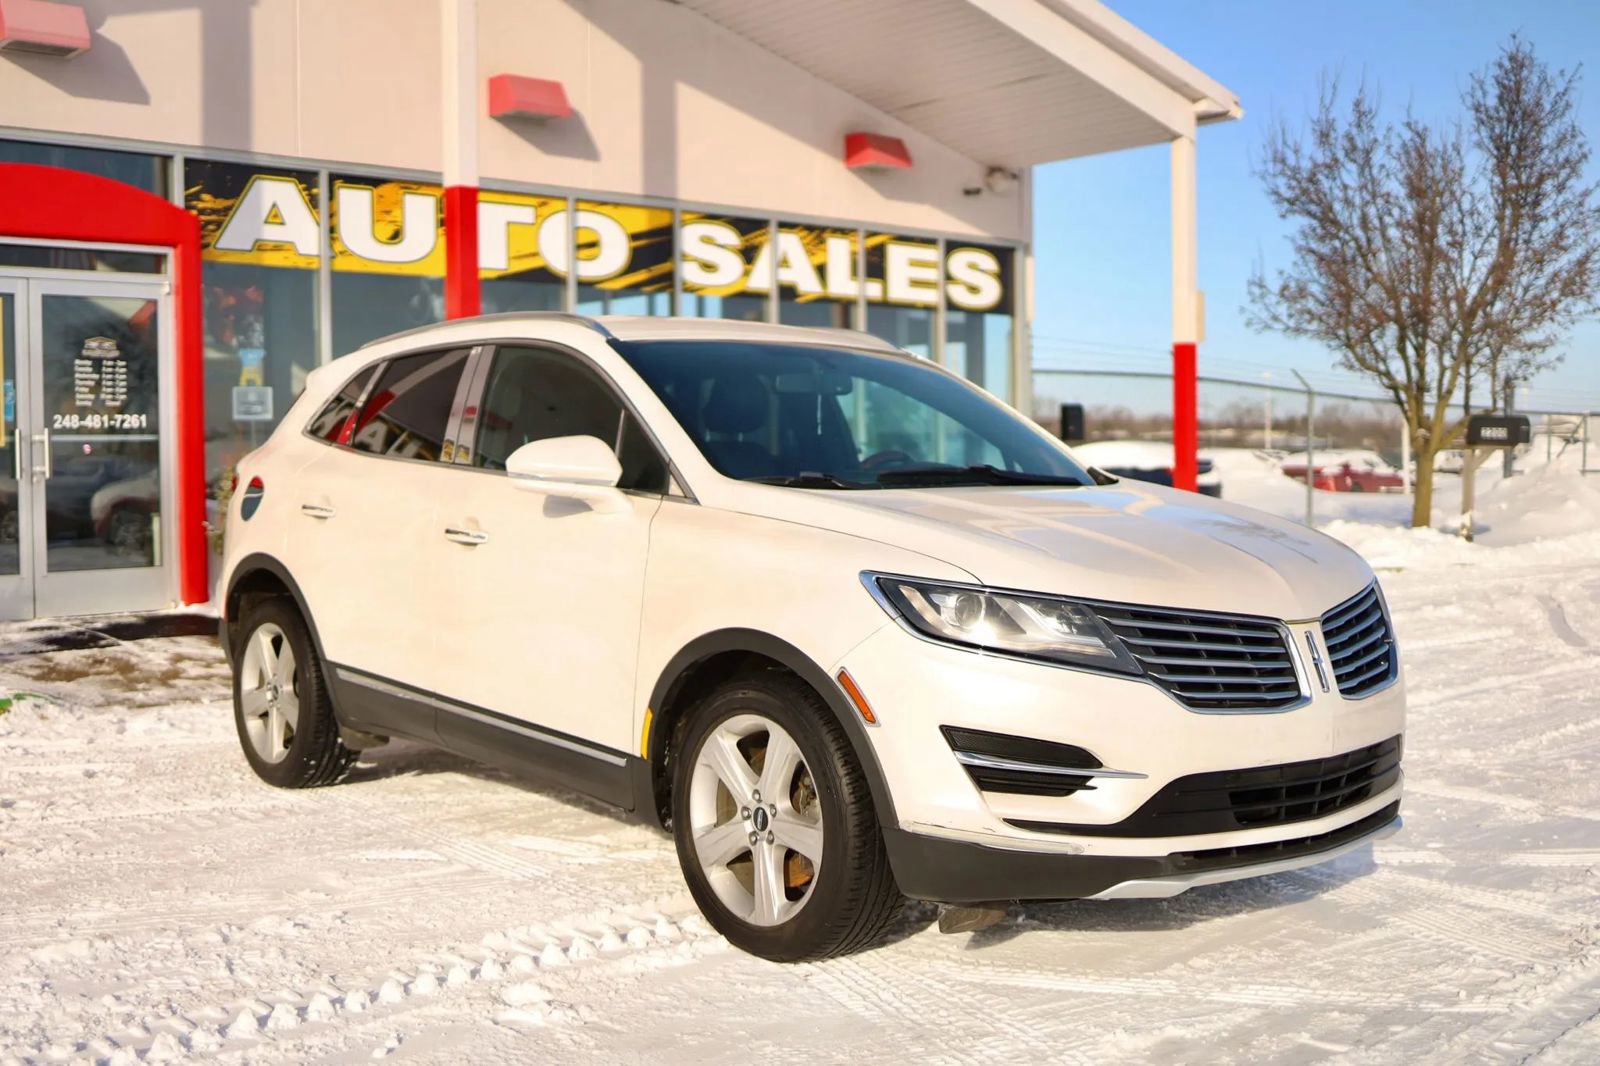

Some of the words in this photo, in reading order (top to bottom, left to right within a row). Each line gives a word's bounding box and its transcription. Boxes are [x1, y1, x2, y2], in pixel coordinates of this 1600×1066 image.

[213, 175, 632, 278] AUTO
[681, 221, 1003, 309] SALES
[53, 413, 147, 429] 248-481-7261
